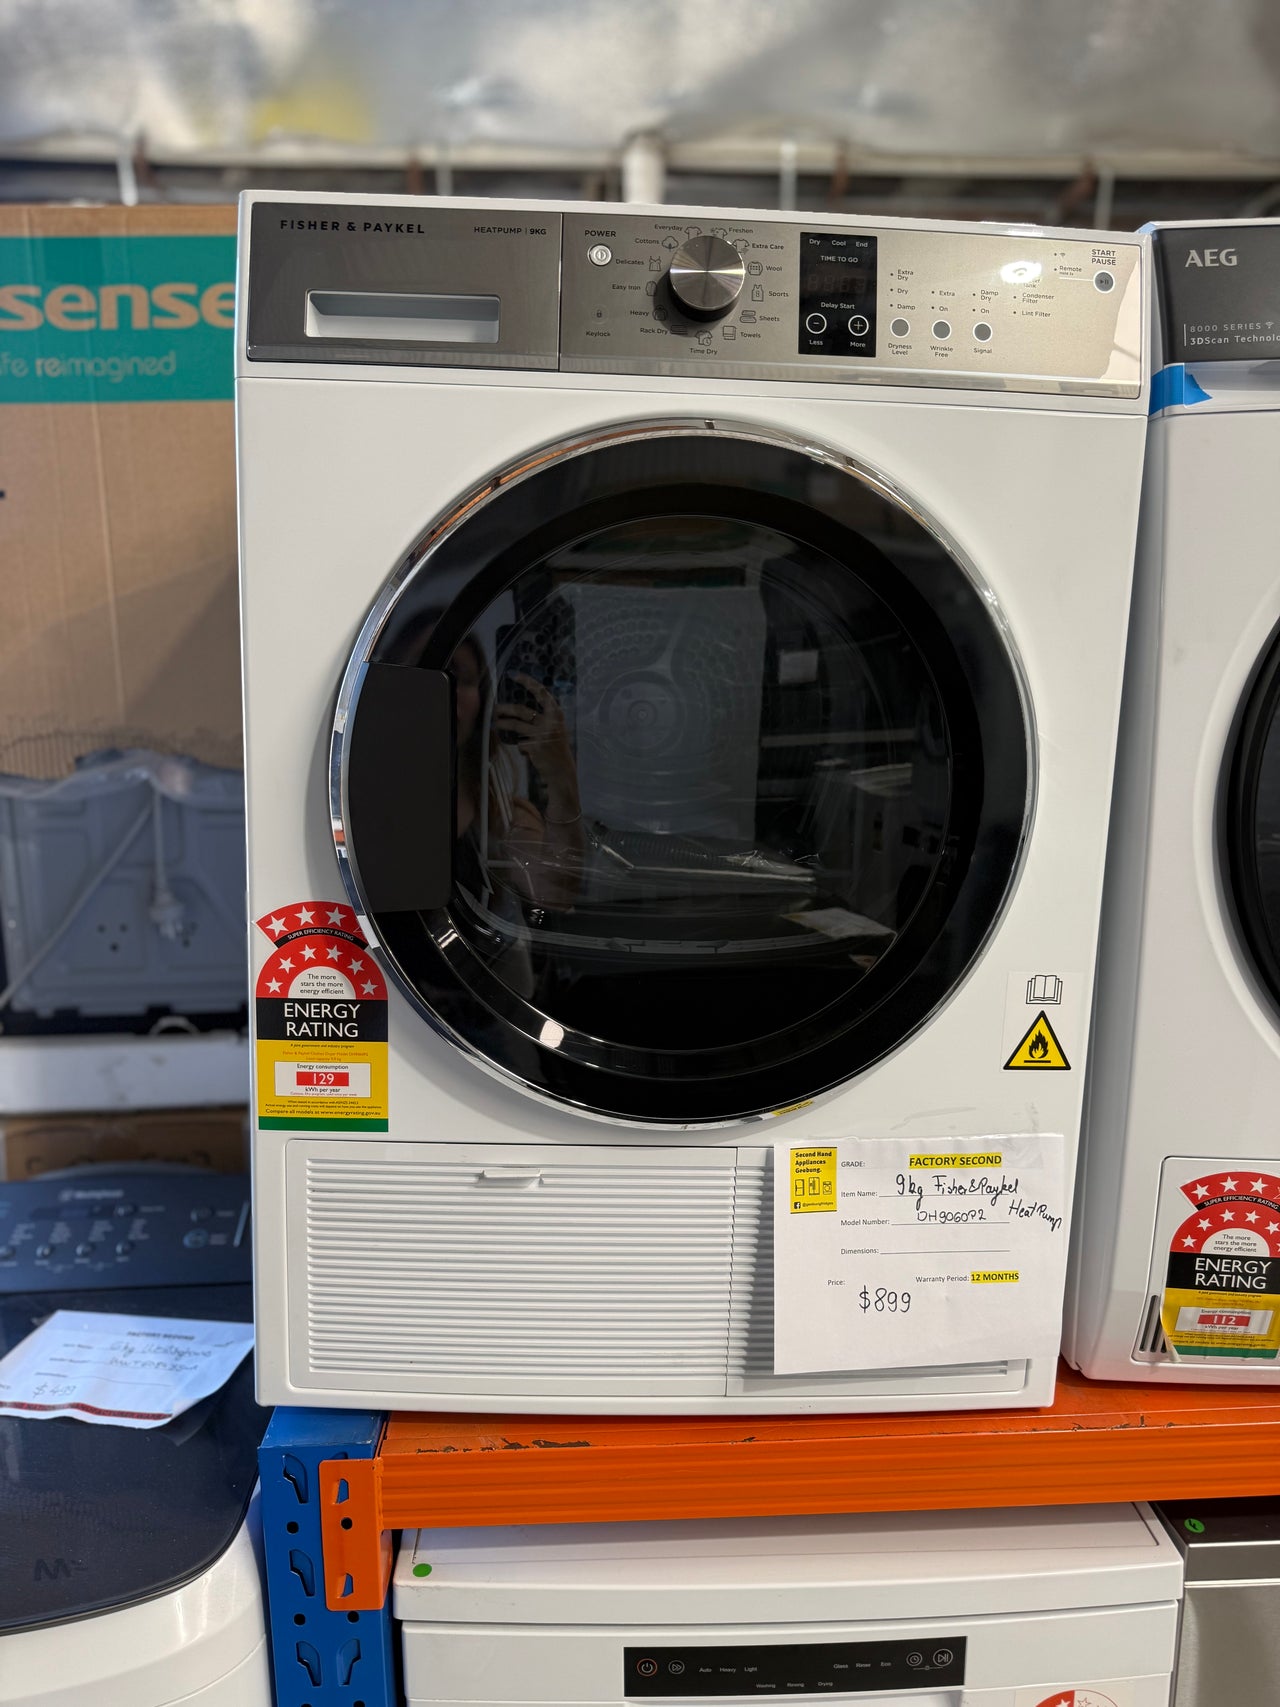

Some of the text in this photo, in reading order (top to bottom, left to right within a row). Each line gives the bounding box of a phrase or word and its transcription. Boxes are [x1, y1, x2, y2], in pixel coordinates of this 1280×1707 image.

[280, 220, 425, 234] FISHER & PAYKEL
[474, 226, 547, 236] HEATPUMP 9KG
[654, 224, 683, 232] Everyday
[584, 230, 616, 238] POWER
[1091, 249, 1116, 257] START
[1185, 248, 1238, 267] AEG
[1091, 258, 1116, 266] PAUSE
[654, 328, 668, 336] Dry
[1190, 322, 1261, 333] 8000 SERIES
[1190, 336, 1229, 346] 3DScan
[706, 348, 718, 356] Dry
[35, 351, 177, 382] reimagined
[287, 930, 304, 940] SUPER
[334, 930, 354, 941] RATING
[284, 1002, 361, 1019] ENERGY
[286, 1021, 359, 1038] RATING
[313, 1073, 335, 1085] 129
[909, 1156, 958, 1166] FACTORY
[959, 1155, 1002, 1166] SECOND
[1204, 1197, 1222, 1206] SUPER
[1257, 1199, 1279, 1209] RATING
[841, 1217, 890, 1226] Model Number:
[841, 1247, 879, 1255] Dimensions:
[1195, 1257, 1272, 1274] ENERGY
[915, 1276, 945, 1284] Warranty
[946, 1274, 970, 1282] Period:
[983, 1272, 1019, 1281] MONTHS
[1195, 1273, 1267, 1290] RATING
[859, 1285, 911, 1313] $899
[1214, 1315, 1236, 1325] 112
